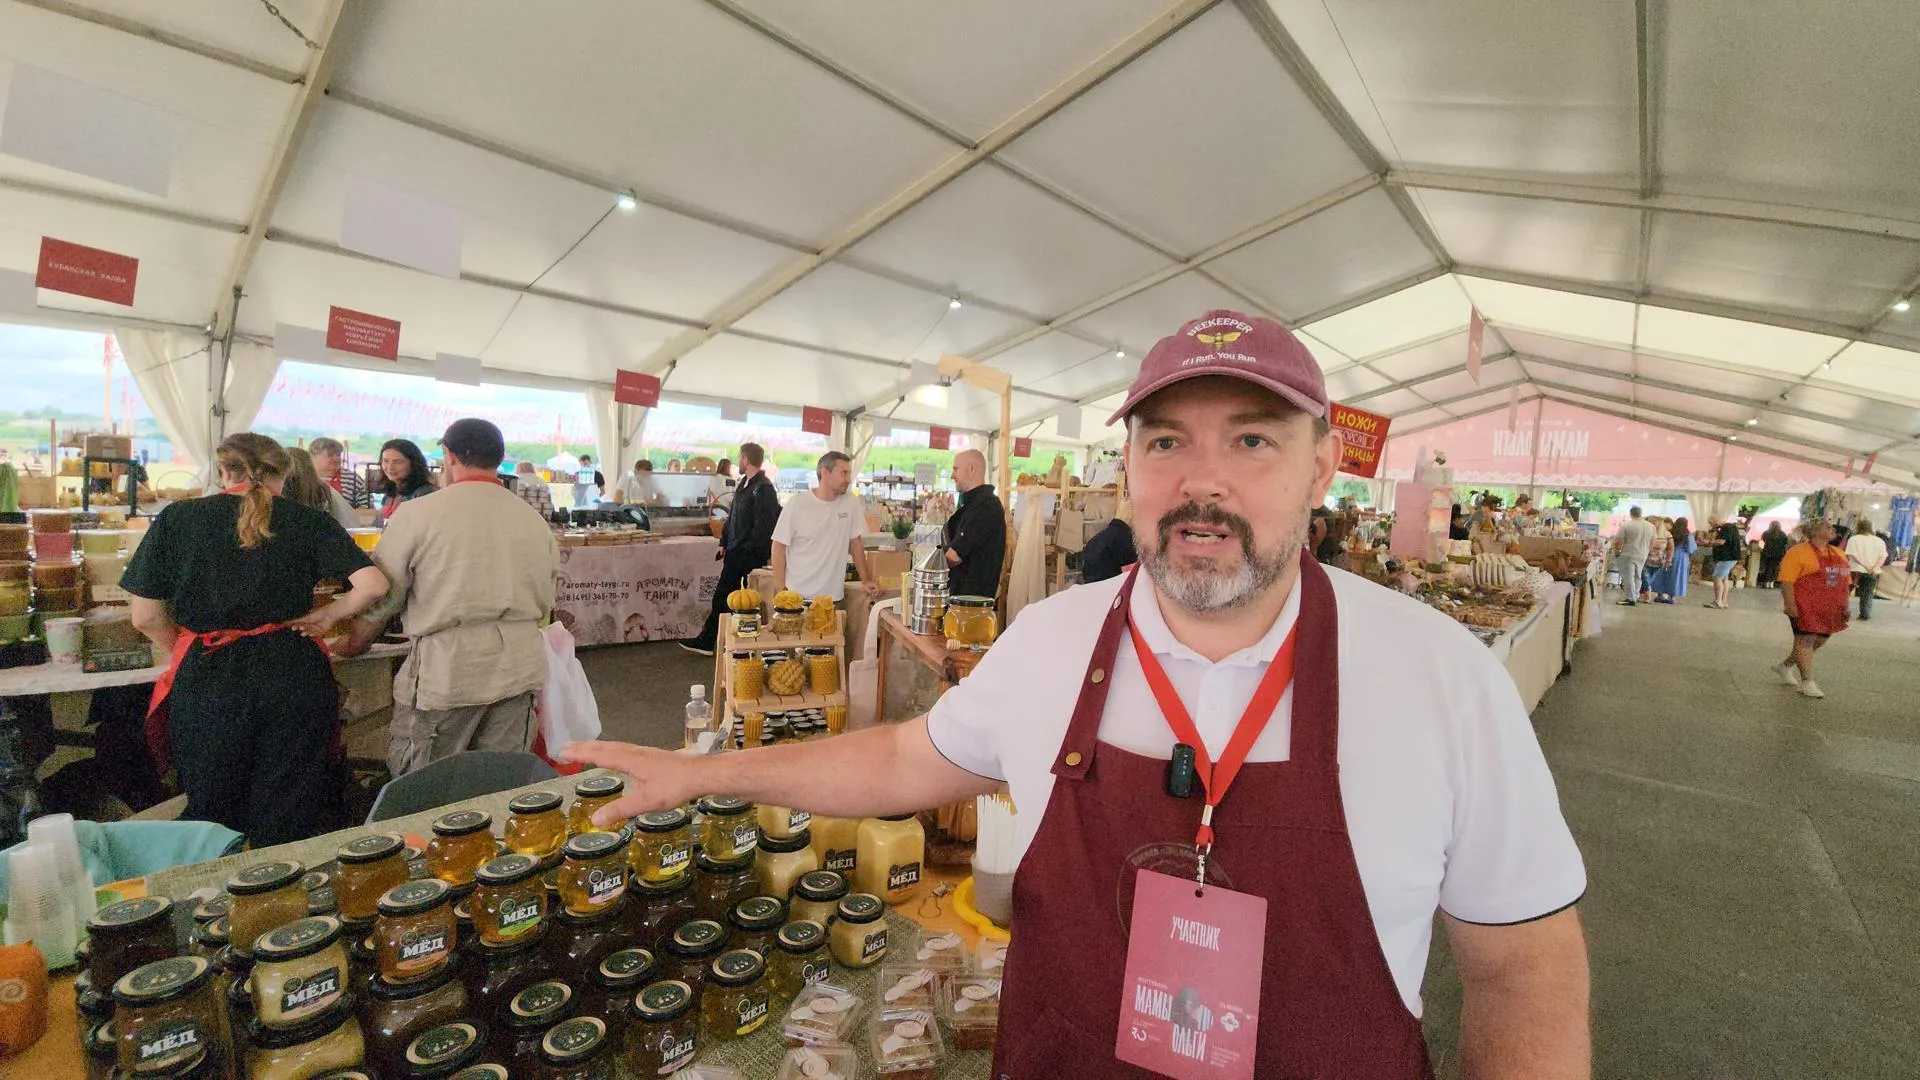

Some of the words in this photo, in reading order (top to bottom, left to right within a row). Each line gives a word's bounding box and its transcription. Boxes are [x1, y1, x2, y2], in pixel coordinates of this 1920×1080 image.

[48, 261, 96, 277] КУБАНСКАЯ
[100, 273, 127, 284] ХАЛВА
[1187, 317, 1253, 337] BEEKEEPER
[1217, 352, 1235, 360] You
[1237, 353, 1257, 363] Run
[1336, 410, 1378, 432] НОЖИ
[566, 581, 630, 590] aromaty-taygi.ru
[636, 577, 690, 592] АРОМАТЫ
[643, 589, 680, 600] ТАЙГИ
[572, 592, 591, 601] (495)
[592, 874, 622, 894] МЁД
[502, 903, 538, 925] МЁД
[1171, 916, 1221, 952] УЧАСТНИК
[402, 935, 445, 958] МЁД
[287, 978, 336, 1007] МЁД
[1134, 984, 1173, 1022] МАМЫ
[740, 1003, 767, 1024] МЁД
[141, 1029, 198, 1058] МЁД
[663, 1039, 693, 1063] МЁД
[1172, 1023, 1207, 1062] ОЛЬГИ
